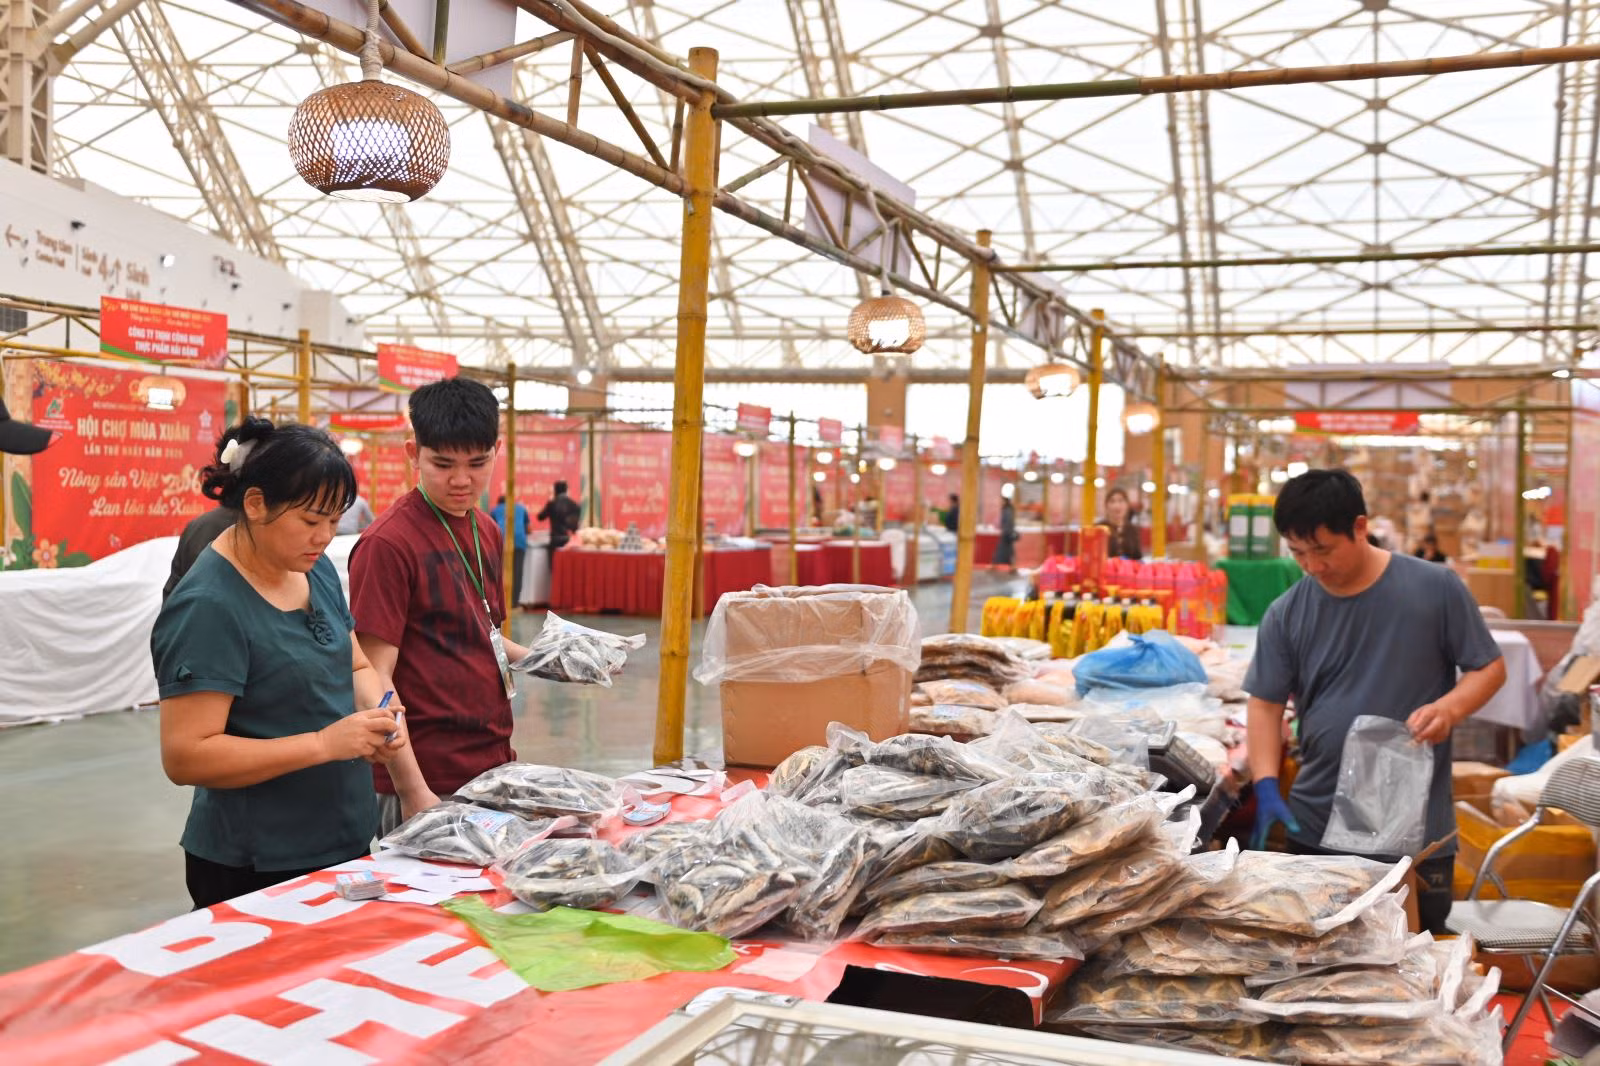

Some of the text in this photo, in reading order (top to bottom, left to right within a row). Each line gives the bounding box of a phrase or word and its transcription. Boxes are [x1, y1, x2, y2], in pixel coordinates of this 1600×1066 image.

[77, 413, 99, 441] HỘI
[102, 419, 128, 443] CHỢ
[130, 417, 157, 440] MÙA
[58, 467, 100, 494] Nông
[89, 496, 120, 517] Lan
